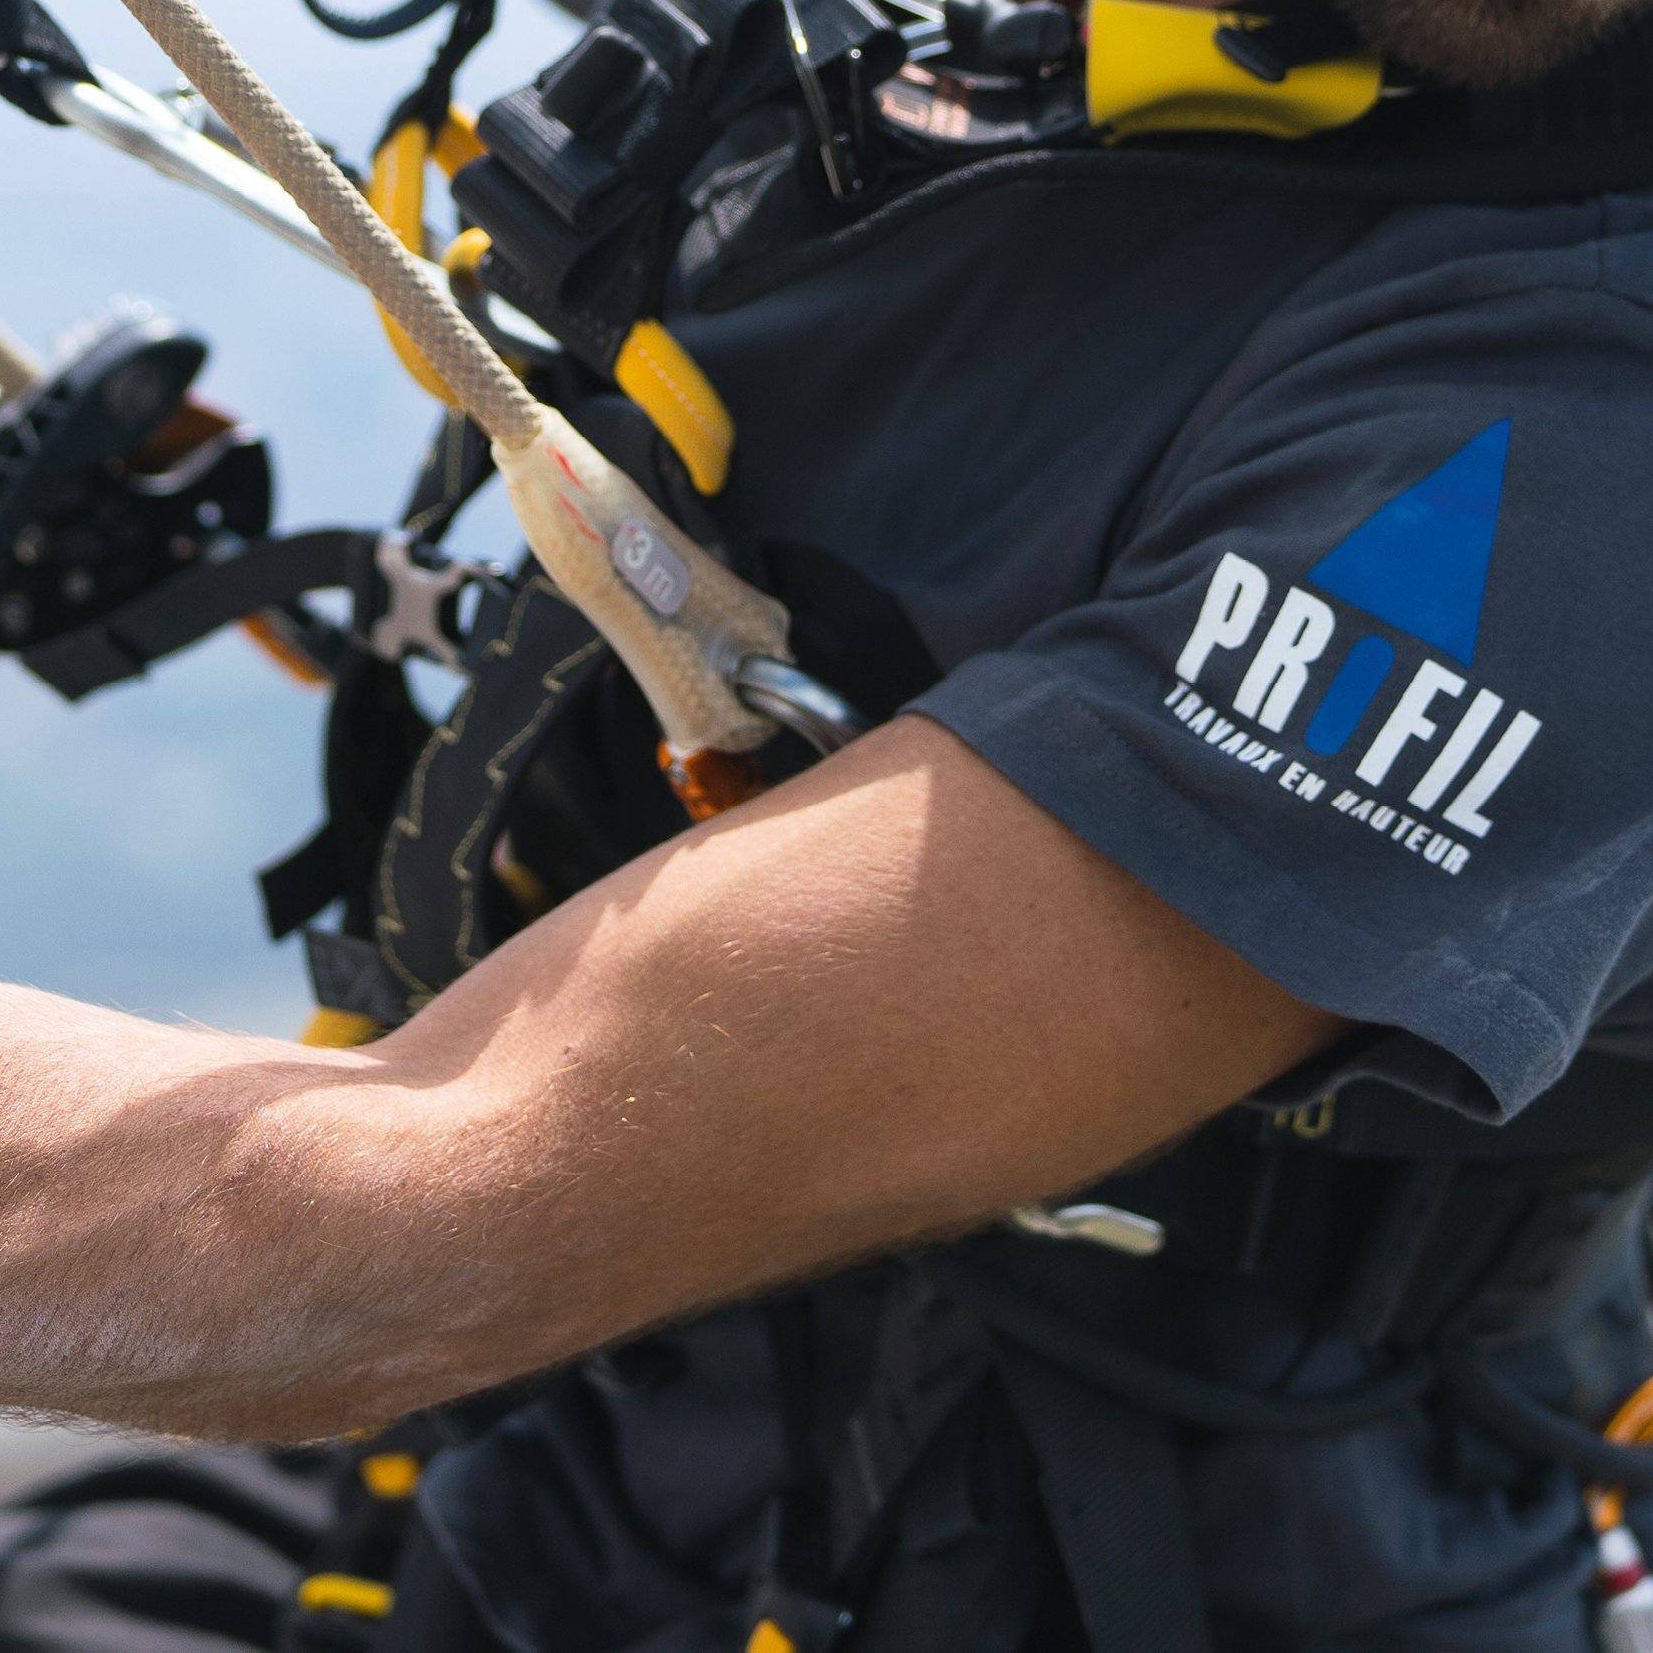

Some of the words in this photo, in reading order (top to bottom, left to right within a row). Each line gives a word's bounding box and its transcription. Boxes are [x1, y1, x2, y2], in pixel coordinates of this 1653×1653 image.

[623, 529, 652, 569] 3
[1163, 681, 1284, 775] TRAVAUX
[1277, 760, 1328, 803] EN
[1330, 789, 1472, 876] HAUTEUR
